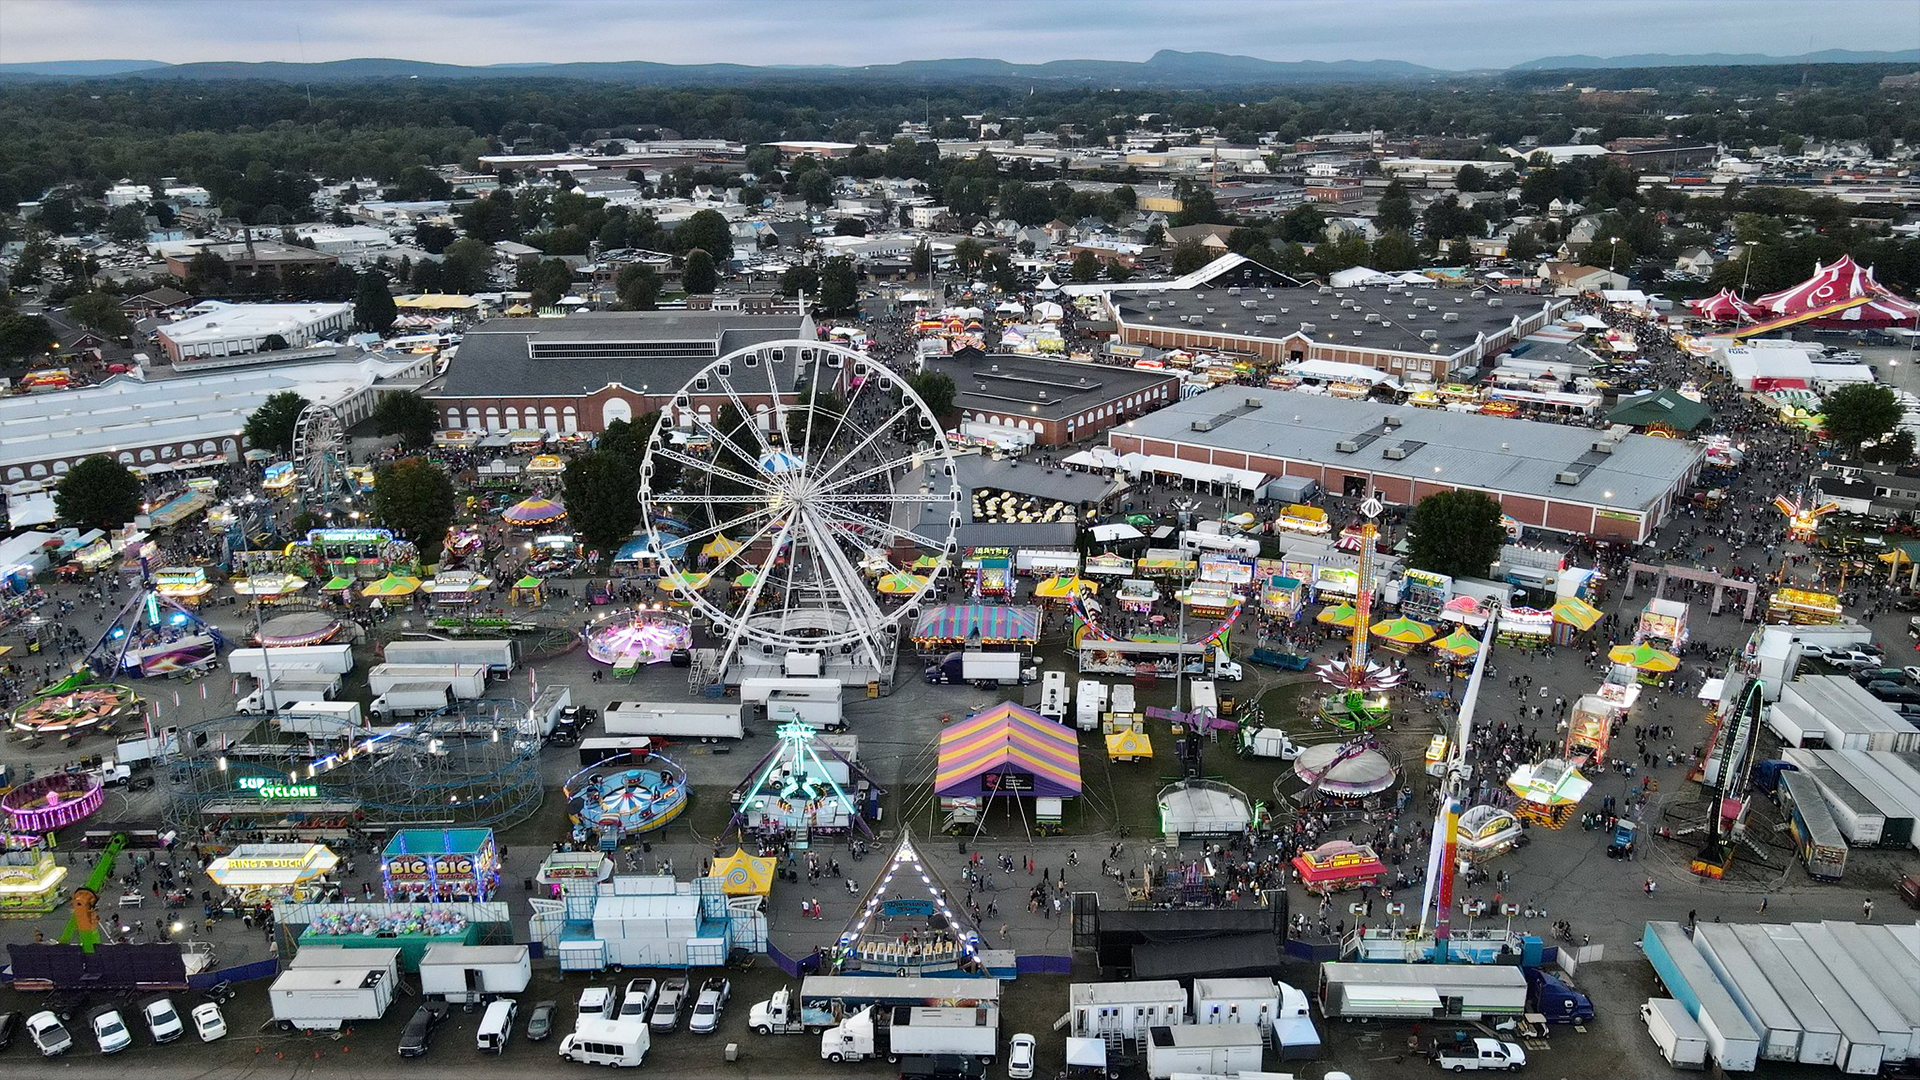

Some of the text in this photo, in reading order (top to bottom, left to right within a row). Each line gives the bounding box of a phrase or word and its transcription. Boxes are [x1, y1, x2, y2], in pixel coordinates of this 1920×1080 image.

[260, 785, 317, 798] CYCLONE
[390, 861, 426, 874] BIG
[436, 860, 472, 874] BIG
